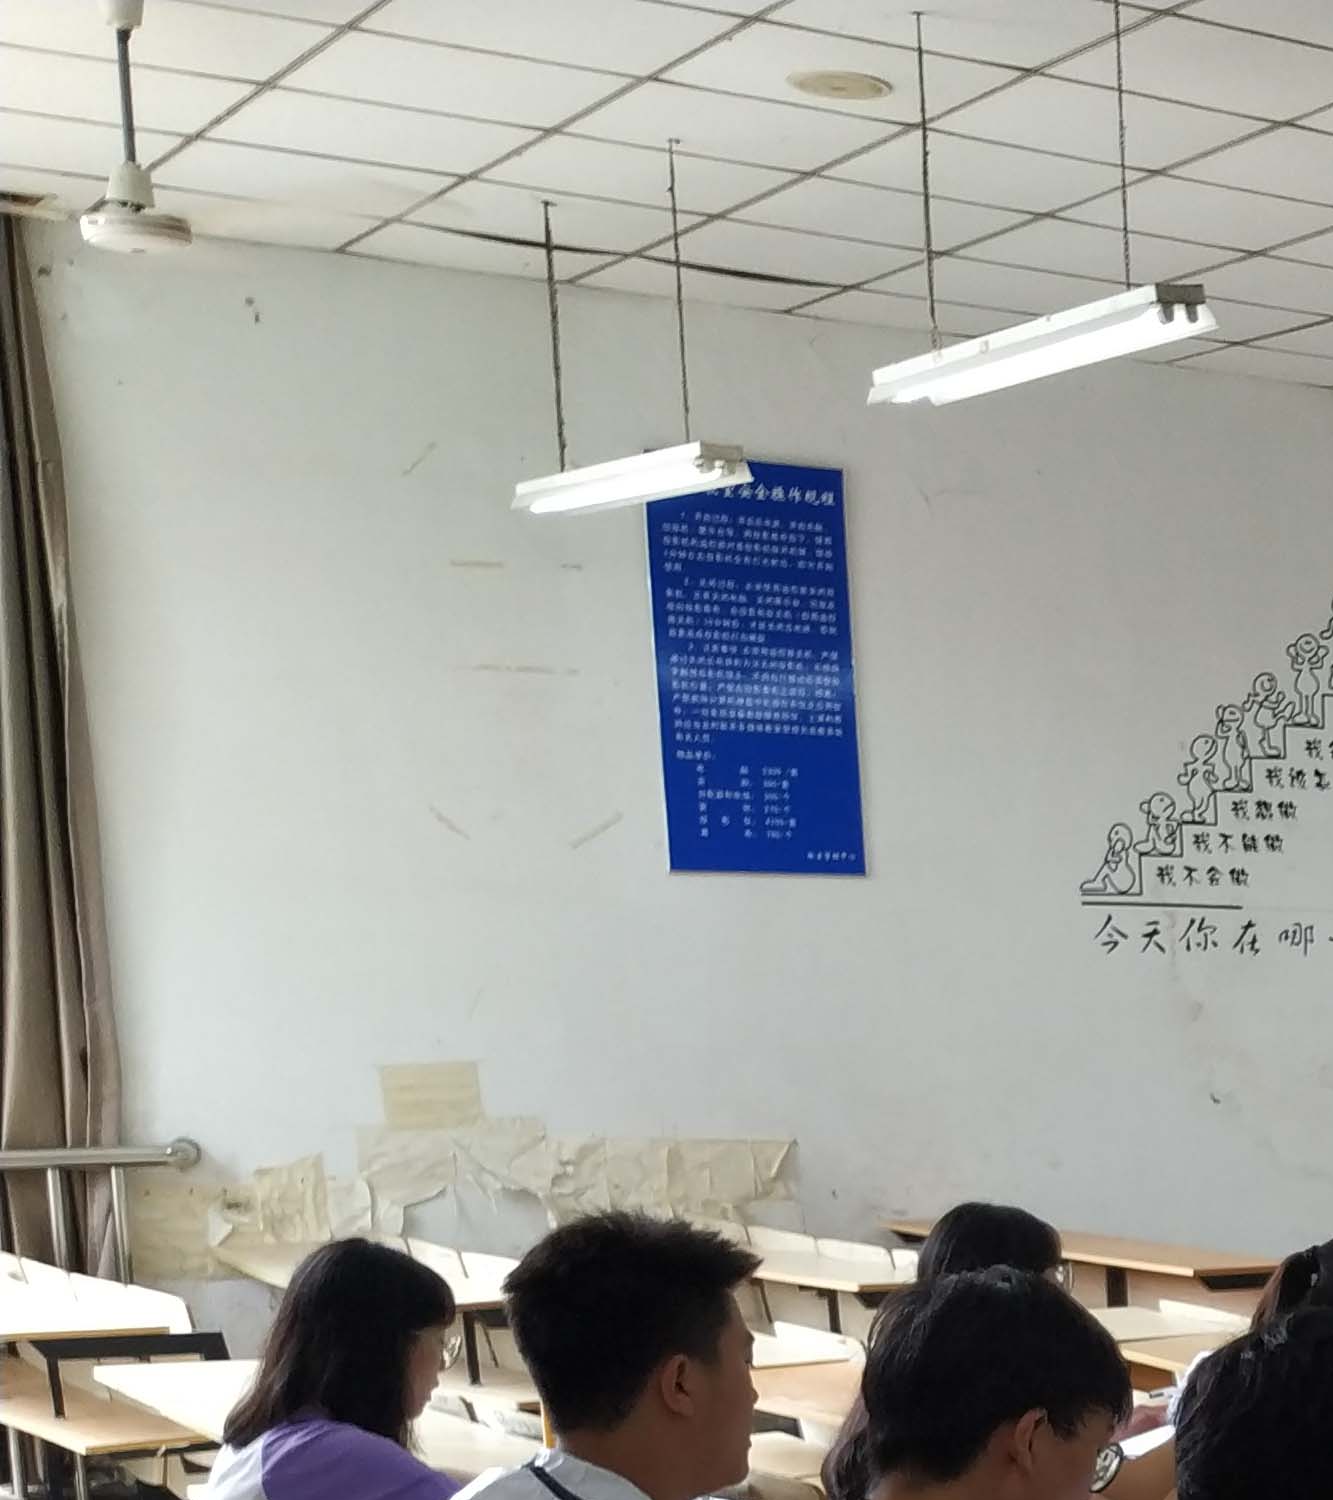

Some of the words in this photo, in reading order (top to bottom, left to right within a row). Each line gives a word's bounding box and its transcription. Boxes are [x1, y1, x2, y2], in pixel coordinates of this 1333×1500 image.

[1231, 799, 1298, 822] 我想做
[1192, 832, 1285, 855] 我不能做
[1156, 865, 1250, 888] 我不会做
